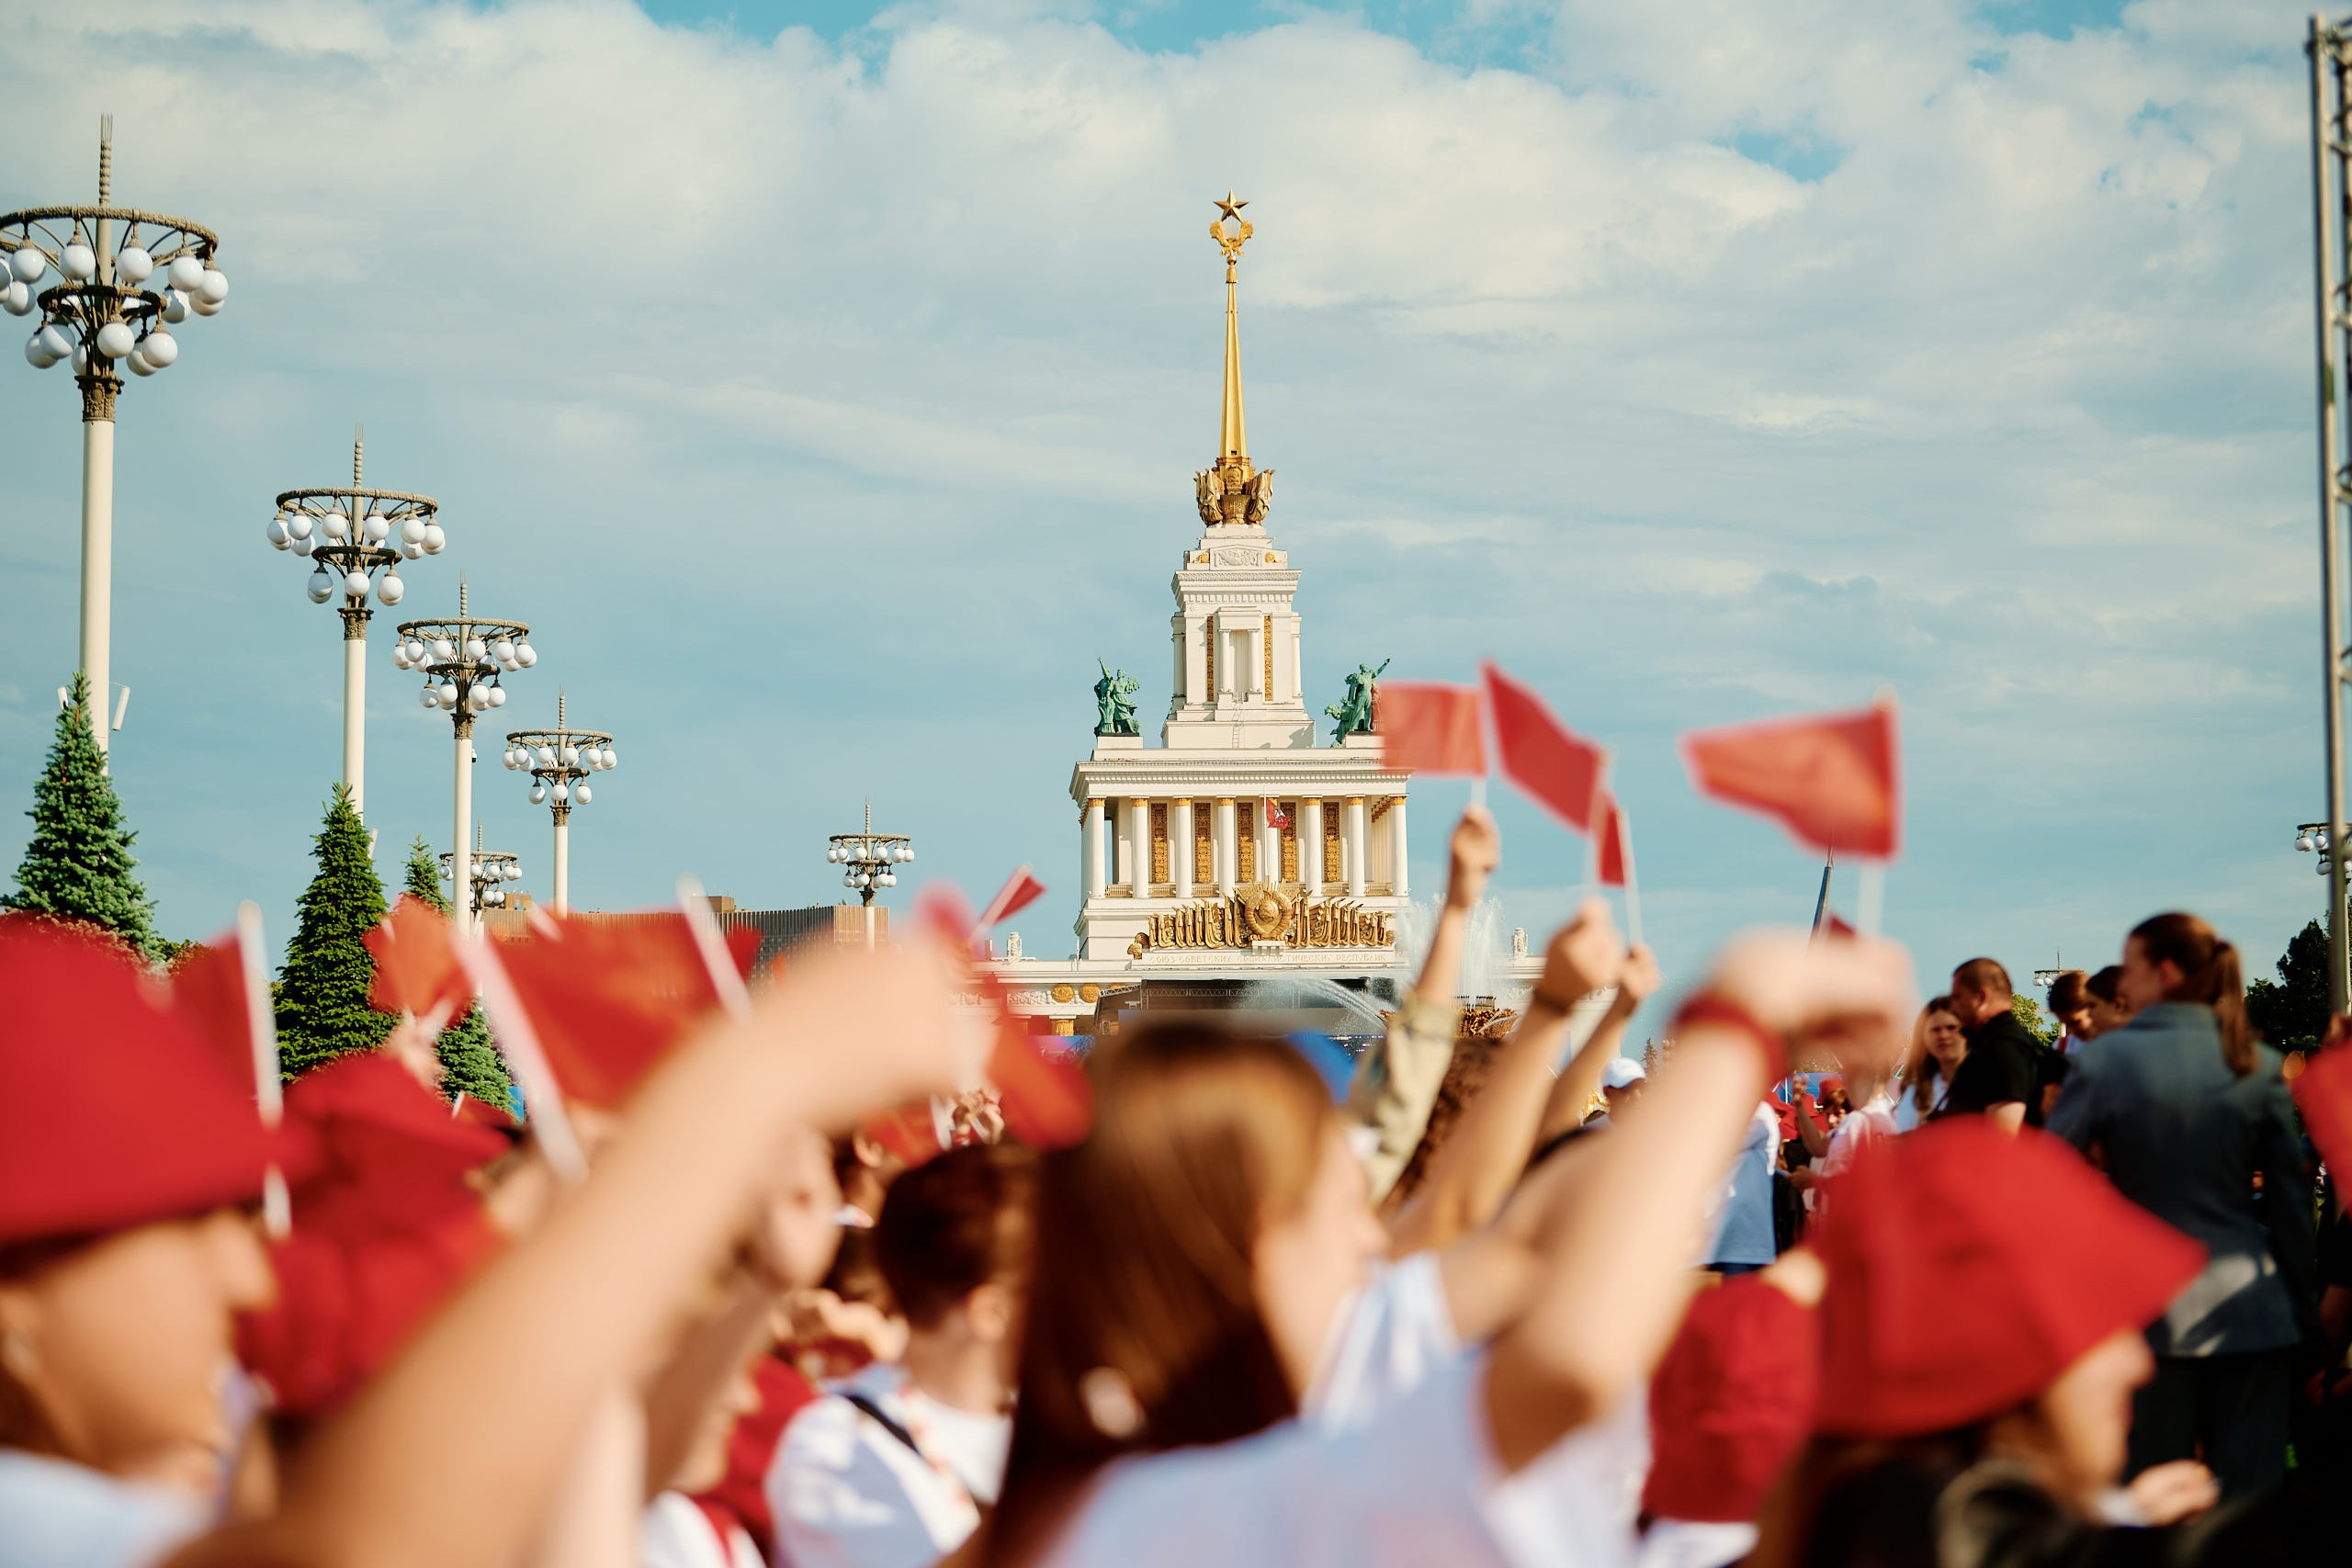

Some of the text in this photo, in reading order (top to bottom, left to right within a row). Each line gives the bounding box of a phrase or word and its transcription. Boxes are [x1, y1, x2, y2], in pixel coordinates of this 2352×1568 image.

[1149, 955, 1175, 964] СОЮЗ
[1179, 955, 1233, 964] СОВЕТСКИХ
[1336, 954, 1387, 963] РЕСПУБЛИК
